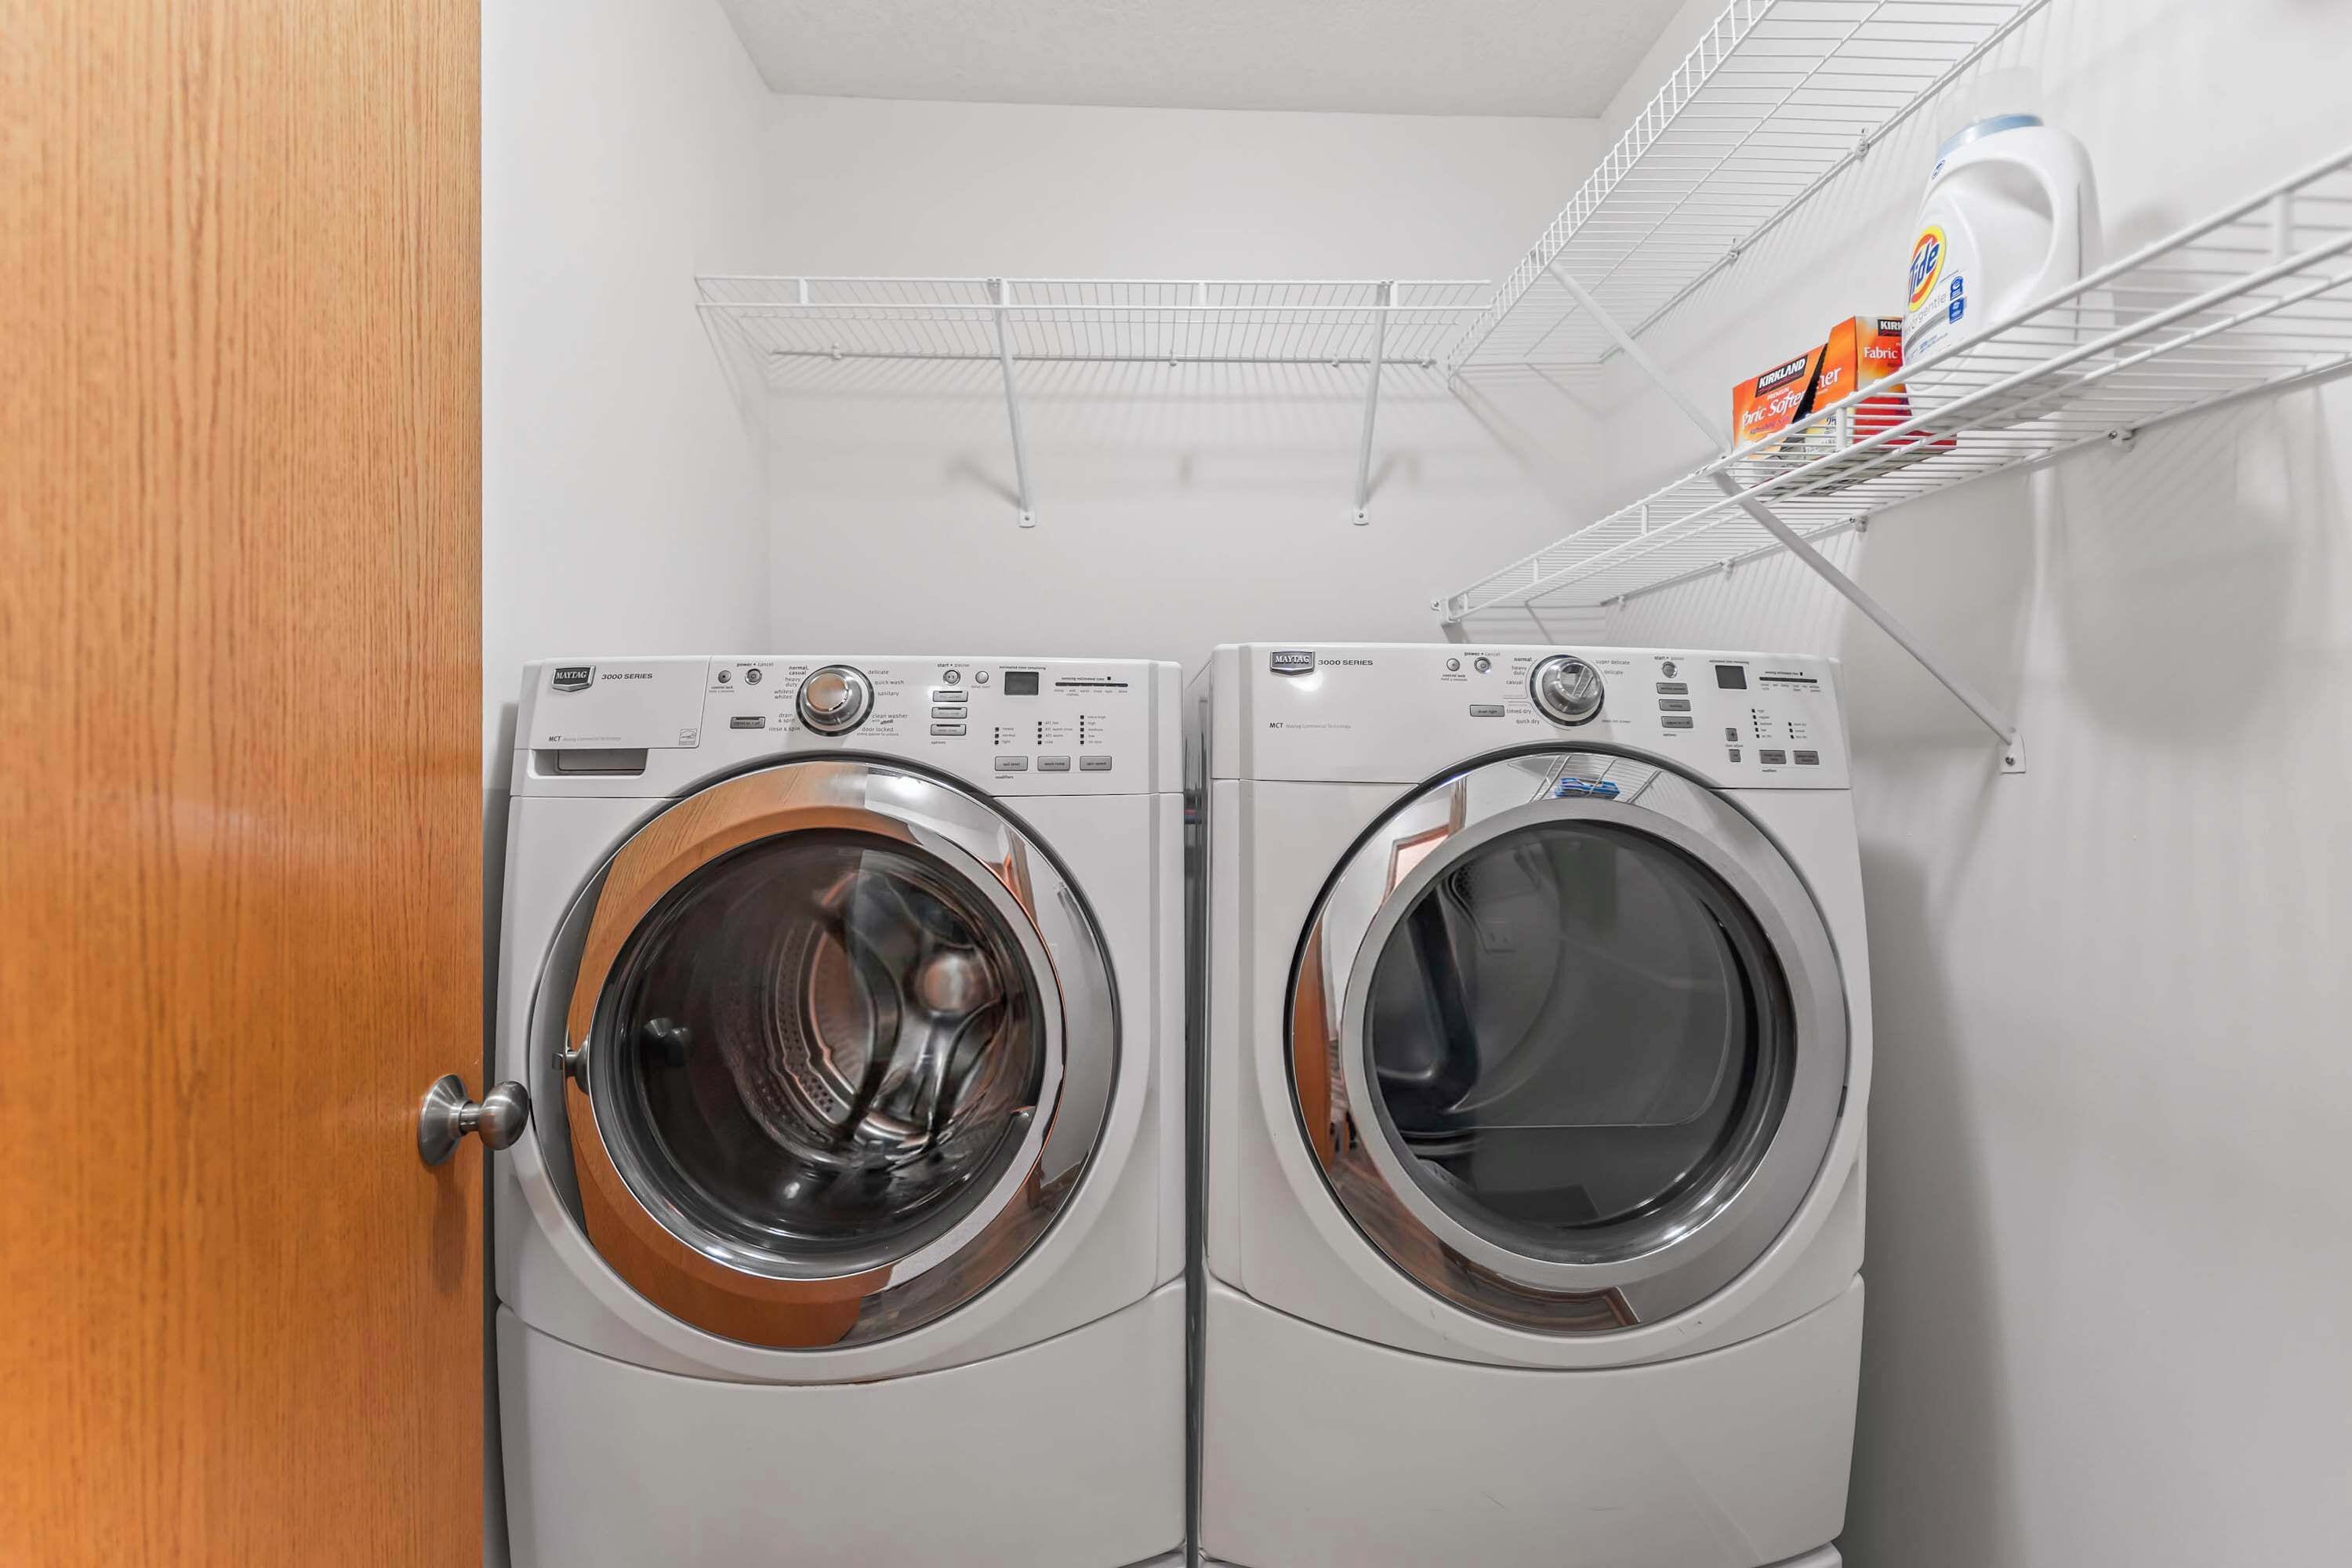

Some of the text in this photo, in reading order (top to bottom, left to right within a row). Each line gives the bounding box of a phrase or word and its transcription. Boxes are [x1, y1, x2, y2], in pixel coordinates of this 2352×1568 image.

[1908, 240, 1940, 304] Tide
[1864, 347, 1899, 359] Fabric
[1759, 358, 1807, 389] KIRKLAND
[1275, 655, 1310, 664] MAYTAG
